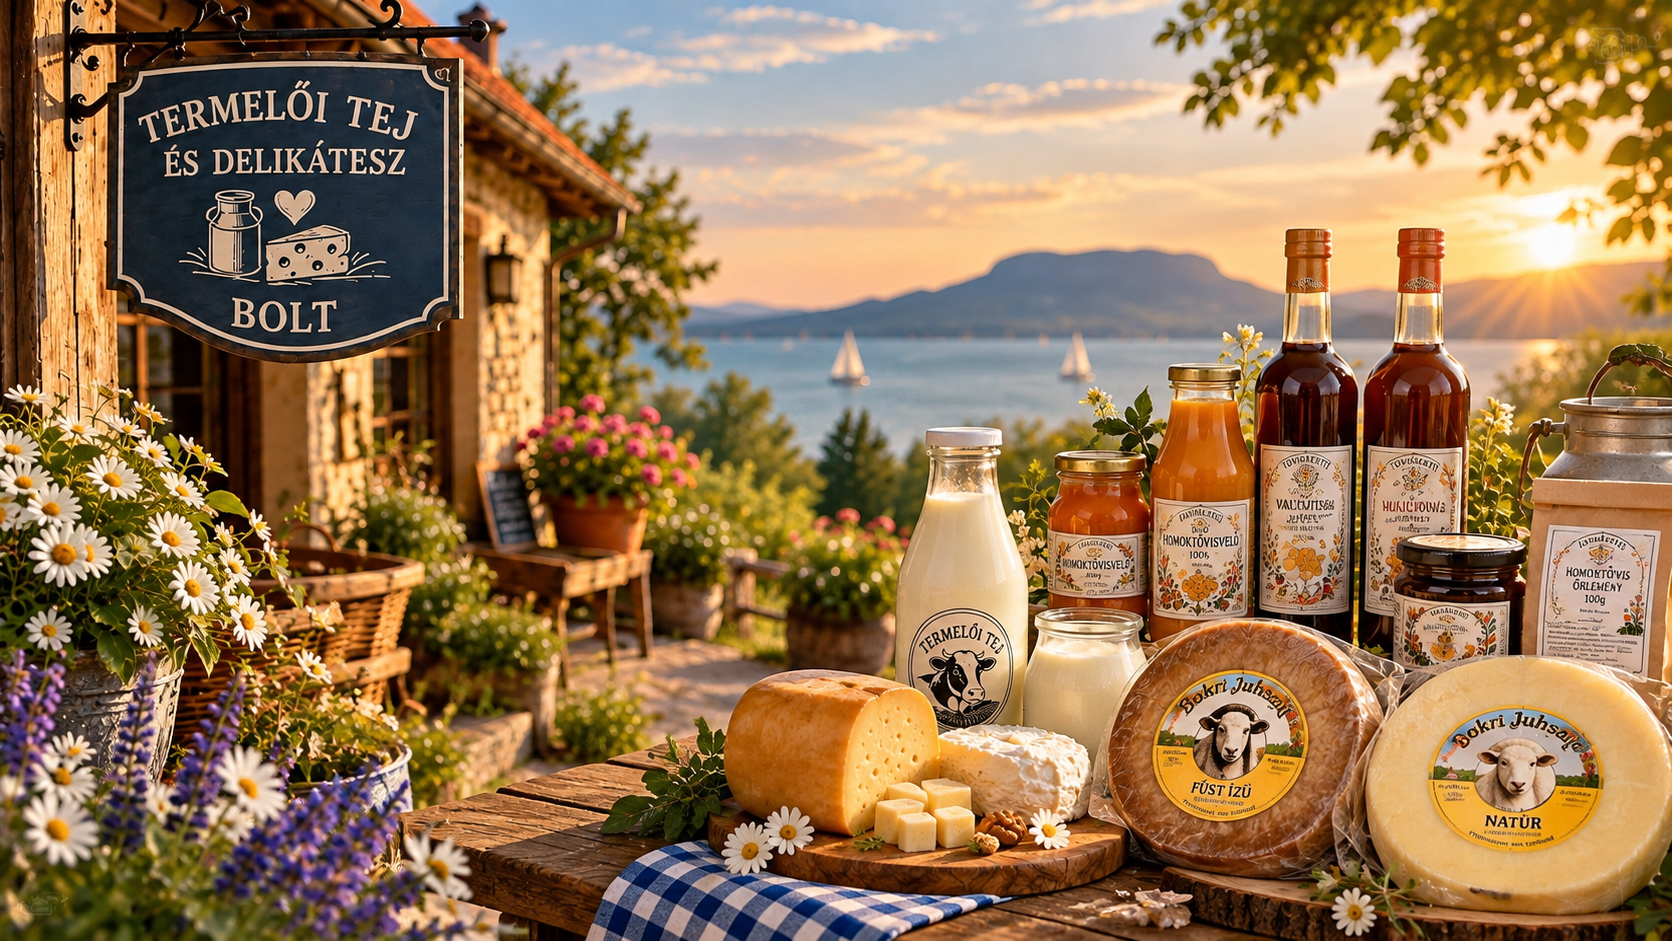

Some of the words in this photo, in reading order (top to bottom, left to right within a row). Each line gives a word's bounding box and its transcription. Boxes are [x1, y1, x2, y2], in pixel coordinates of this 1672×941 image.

[138, 80, 329, 143] TERMELŐI
[347, 95, 419, 141] TEJ
[164, 145, 199, 178] ÉS
[213, 140, 406, 176] DELIKÁTESZ
[231, 297, 338, 334] BOLT
[1584, 594, 1606, 607] 100g
